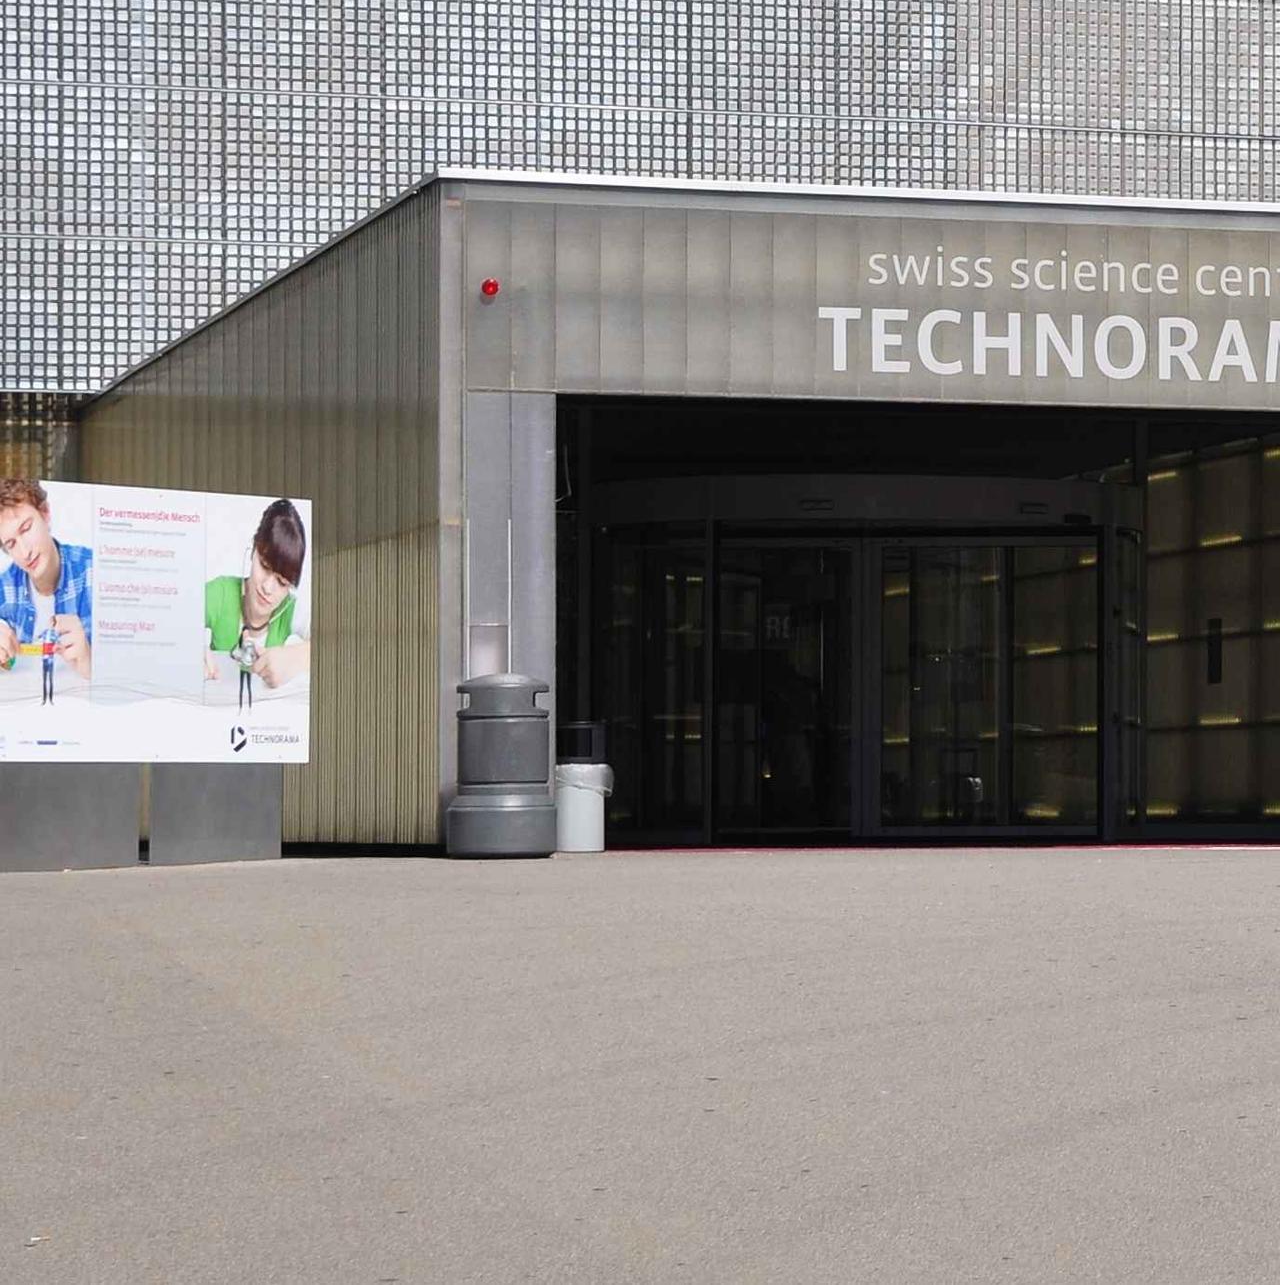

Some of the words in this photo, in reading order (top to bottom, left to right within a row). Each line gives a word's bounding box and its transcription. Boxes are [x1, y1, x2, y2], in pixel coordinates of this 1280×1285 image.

[867, 246, 994, 289] swiss
[1010, 250, 1179, 295] science
[251, 733, 300, 744] TECHNORAMA
